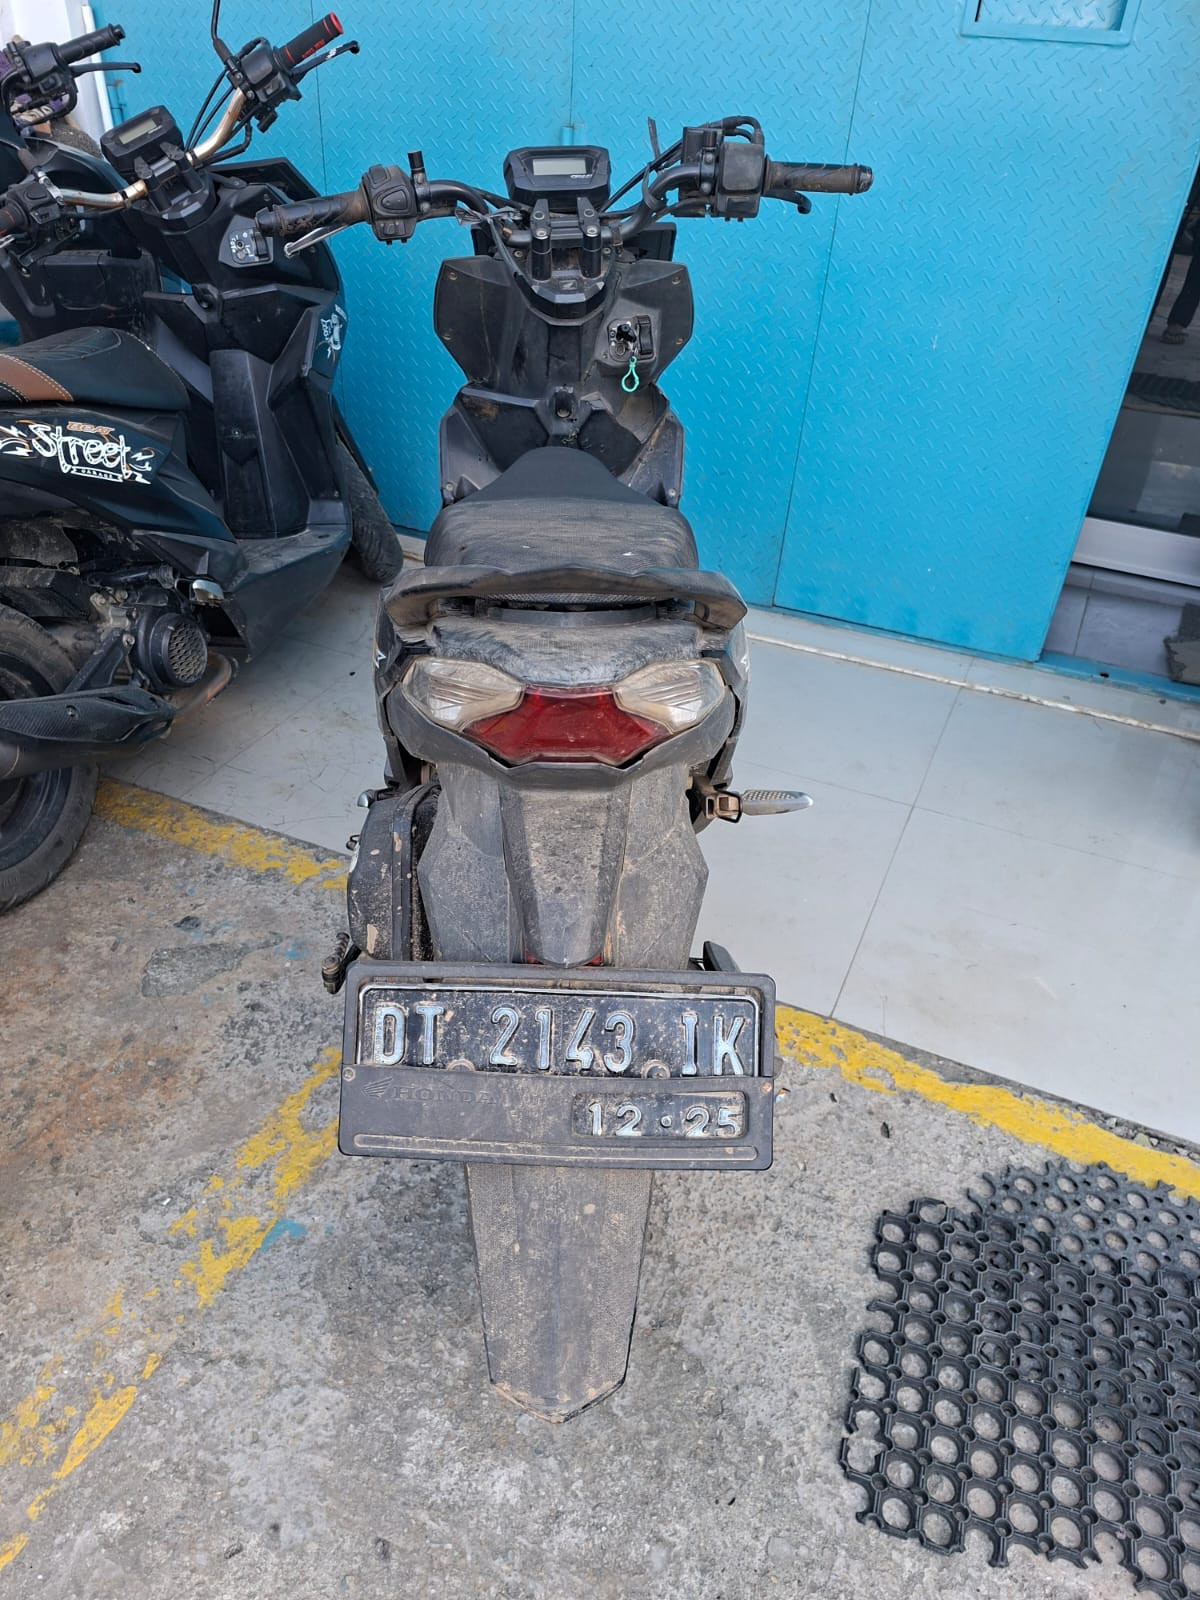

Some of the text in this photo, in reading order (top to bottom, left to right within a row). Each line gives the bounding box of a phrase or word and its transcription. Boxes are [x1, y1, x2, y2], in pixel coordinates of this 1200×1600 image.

[29, 424, 131, 479] Street
[375, 1005, 745, 1077] DT 2143 IK
[391, 1086, 498, 1105] HONDA
